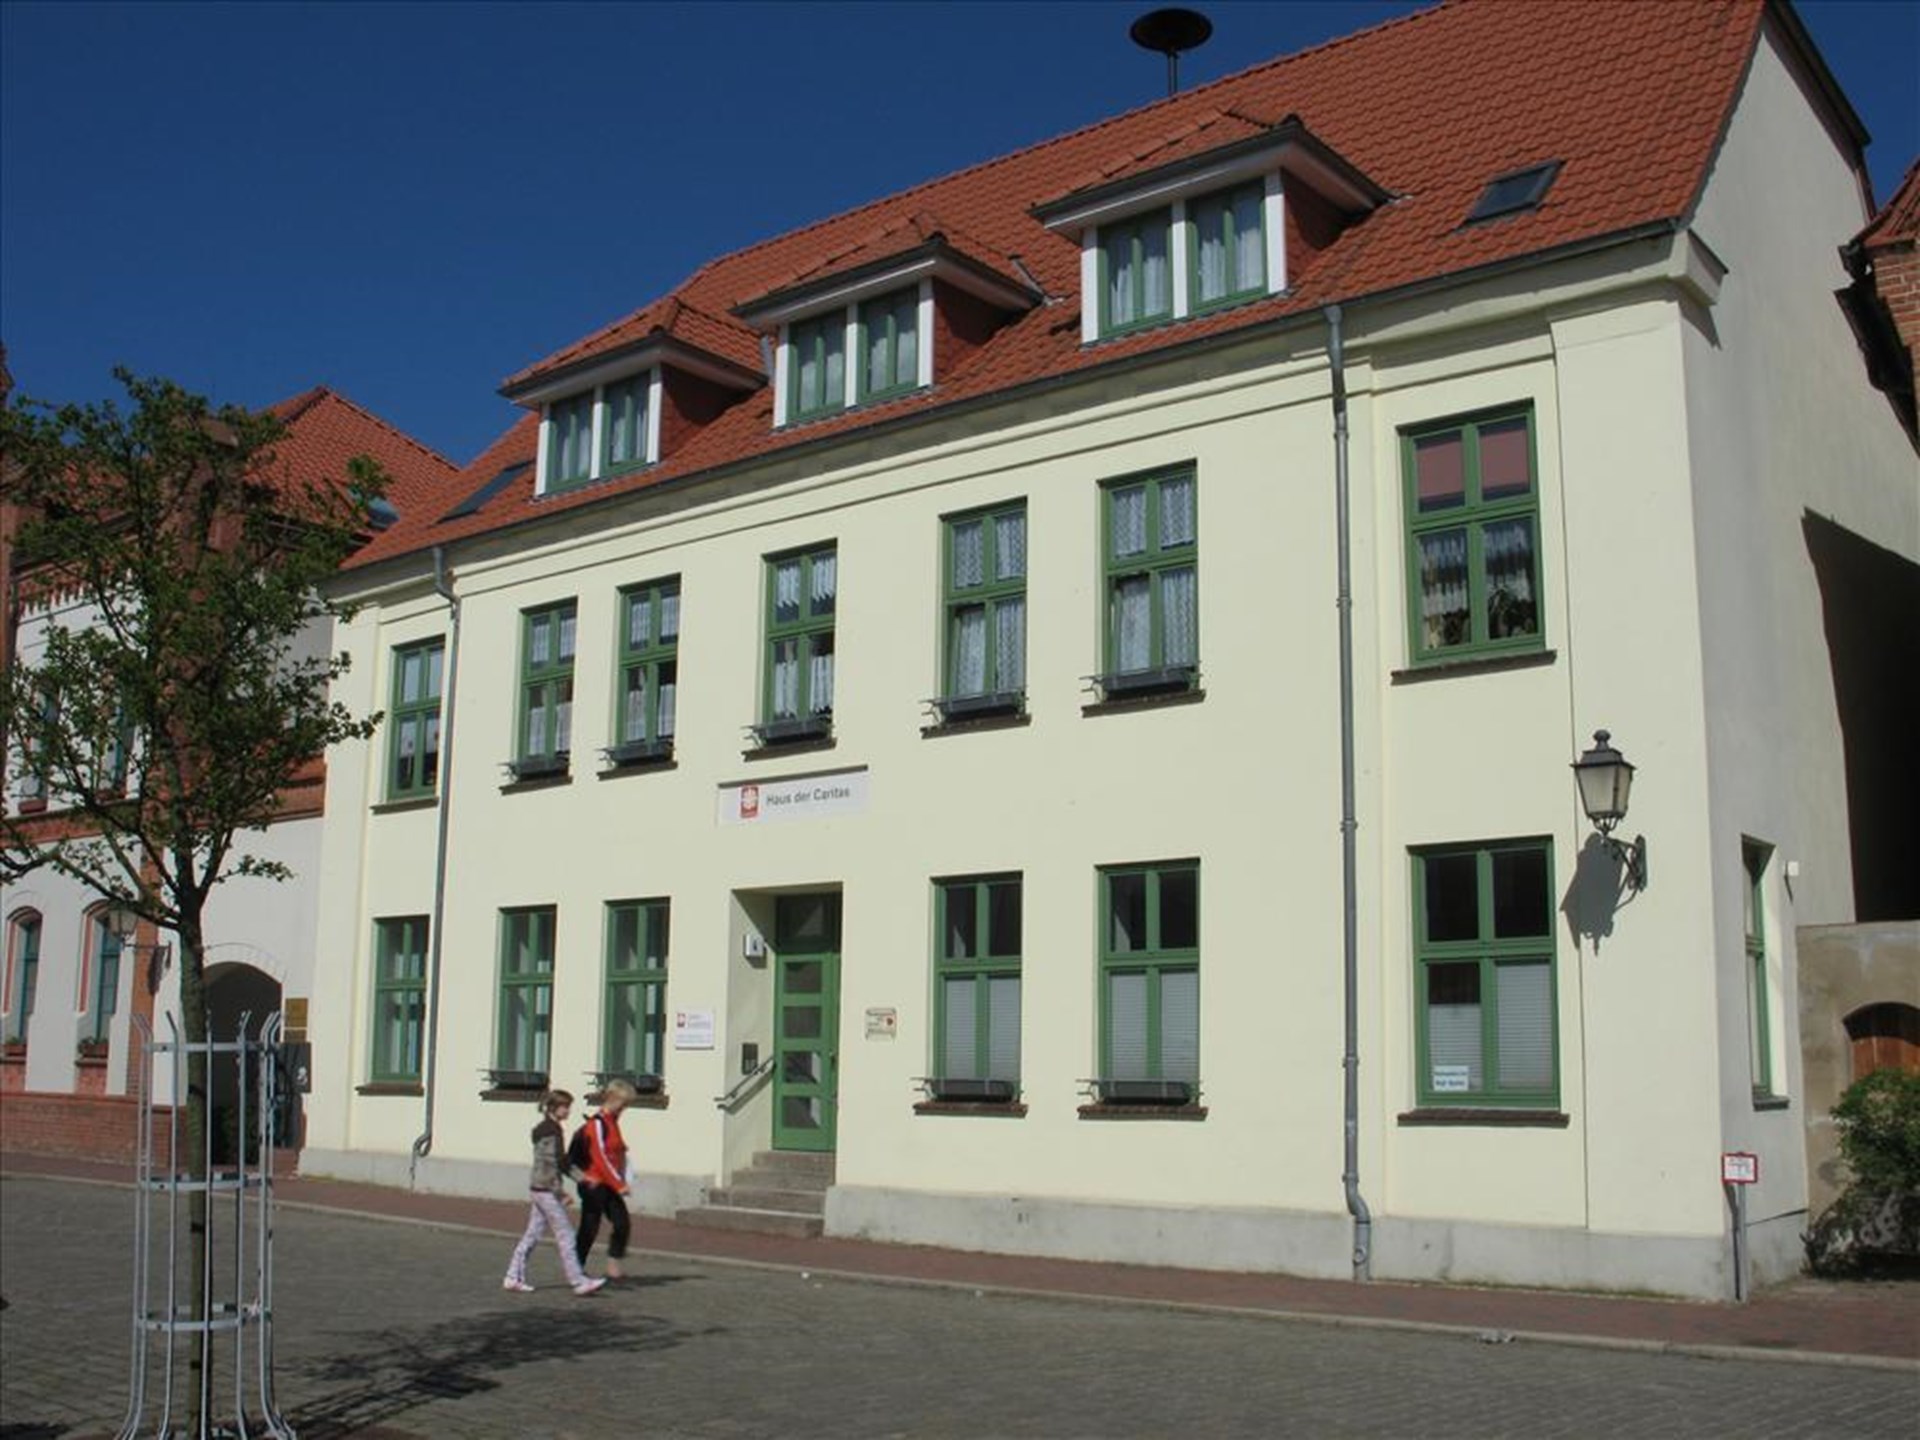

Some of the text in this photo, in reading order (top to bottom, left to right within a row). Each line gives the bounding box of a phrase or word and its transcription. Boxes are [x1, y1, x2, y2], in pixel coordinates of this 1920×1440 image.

[767, 787, 850, 805] Haus der Caritas
